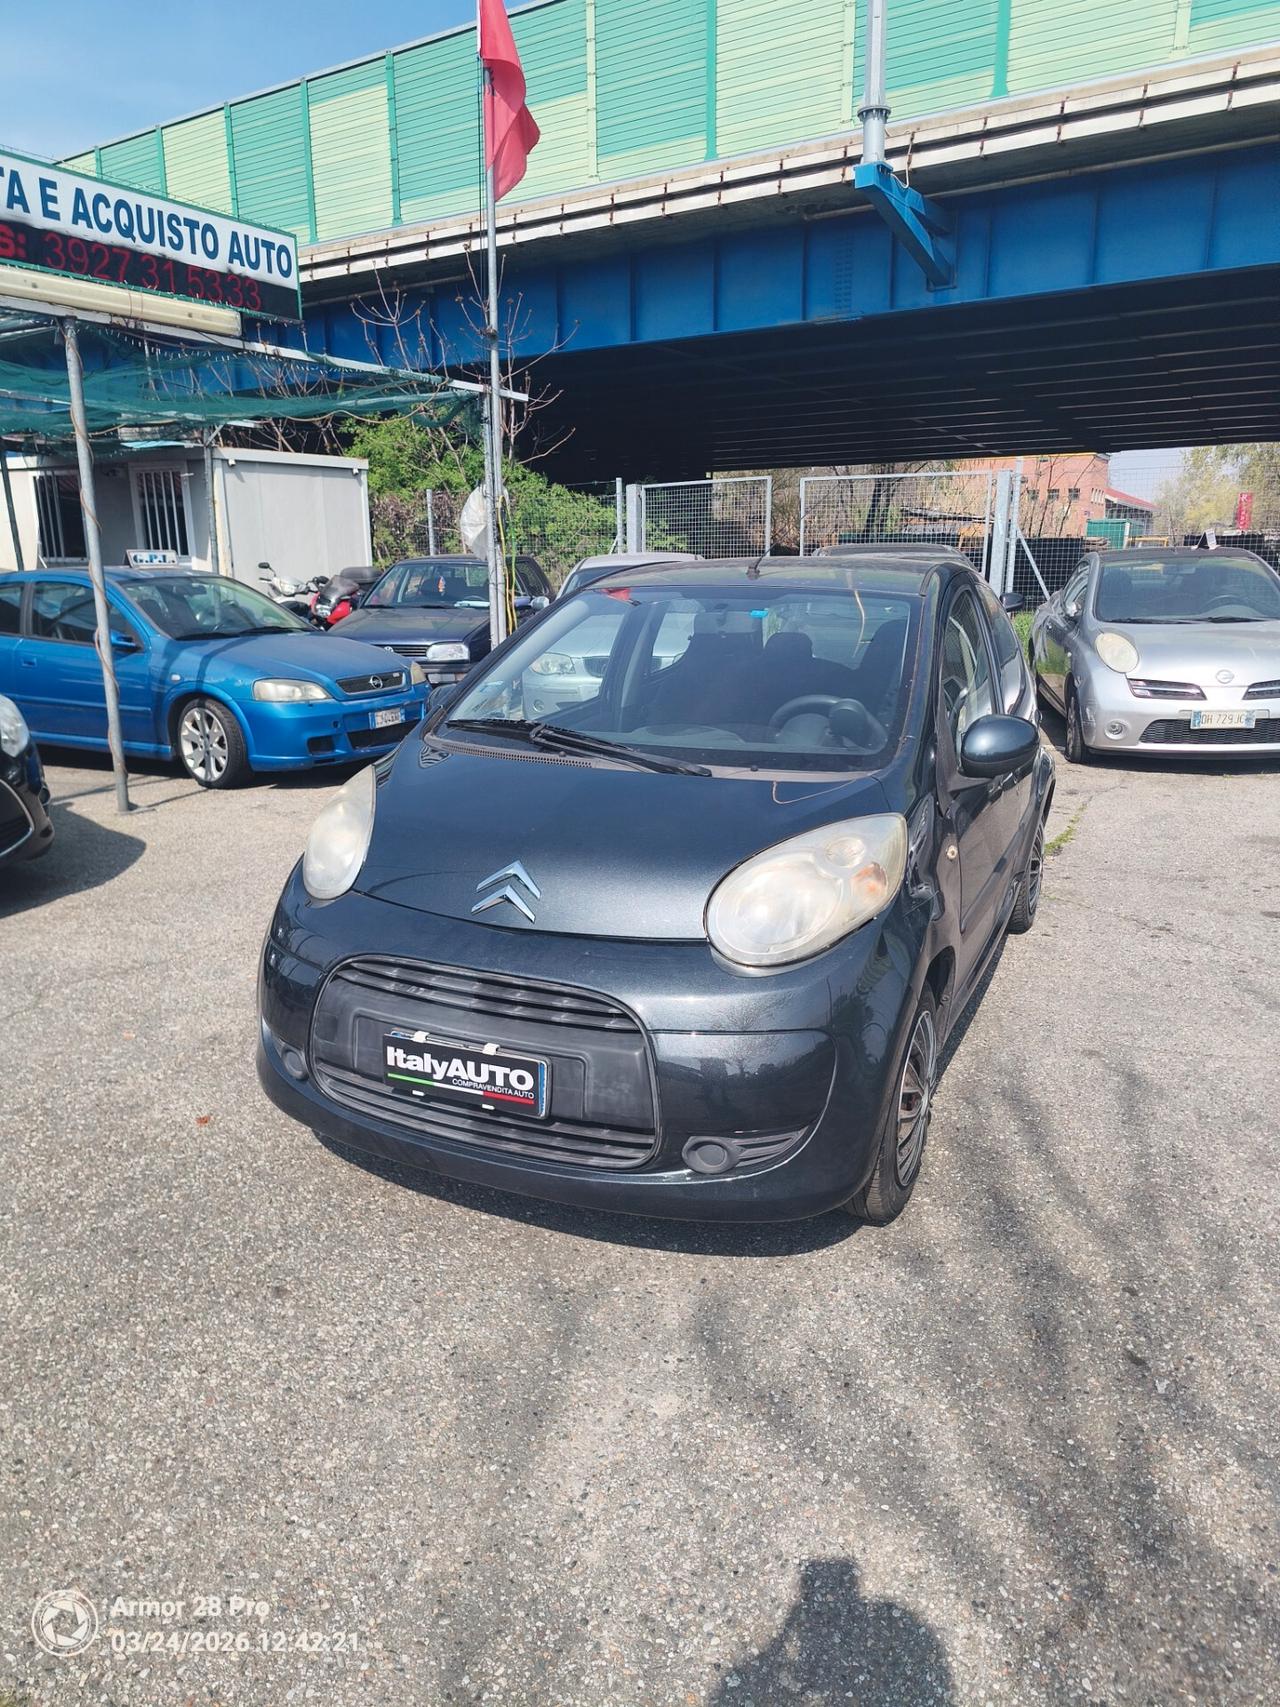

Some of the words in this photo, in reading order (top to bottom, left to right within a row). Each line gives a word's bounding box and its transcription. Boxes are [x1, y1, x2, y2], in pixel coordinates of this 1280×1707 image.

[0, 166, 31, 214] A
[39, 177, 61, 221] E
[72, 187, 219, 260] ACQUISTO
[228, 231, 293, 278] AUTO
[387, 1046, 534, 1089] ItalyAUTO
[452, 1078, 514, 1095] COMPRAVENDITA
[513, 1090, 535, 1099] AUTO
